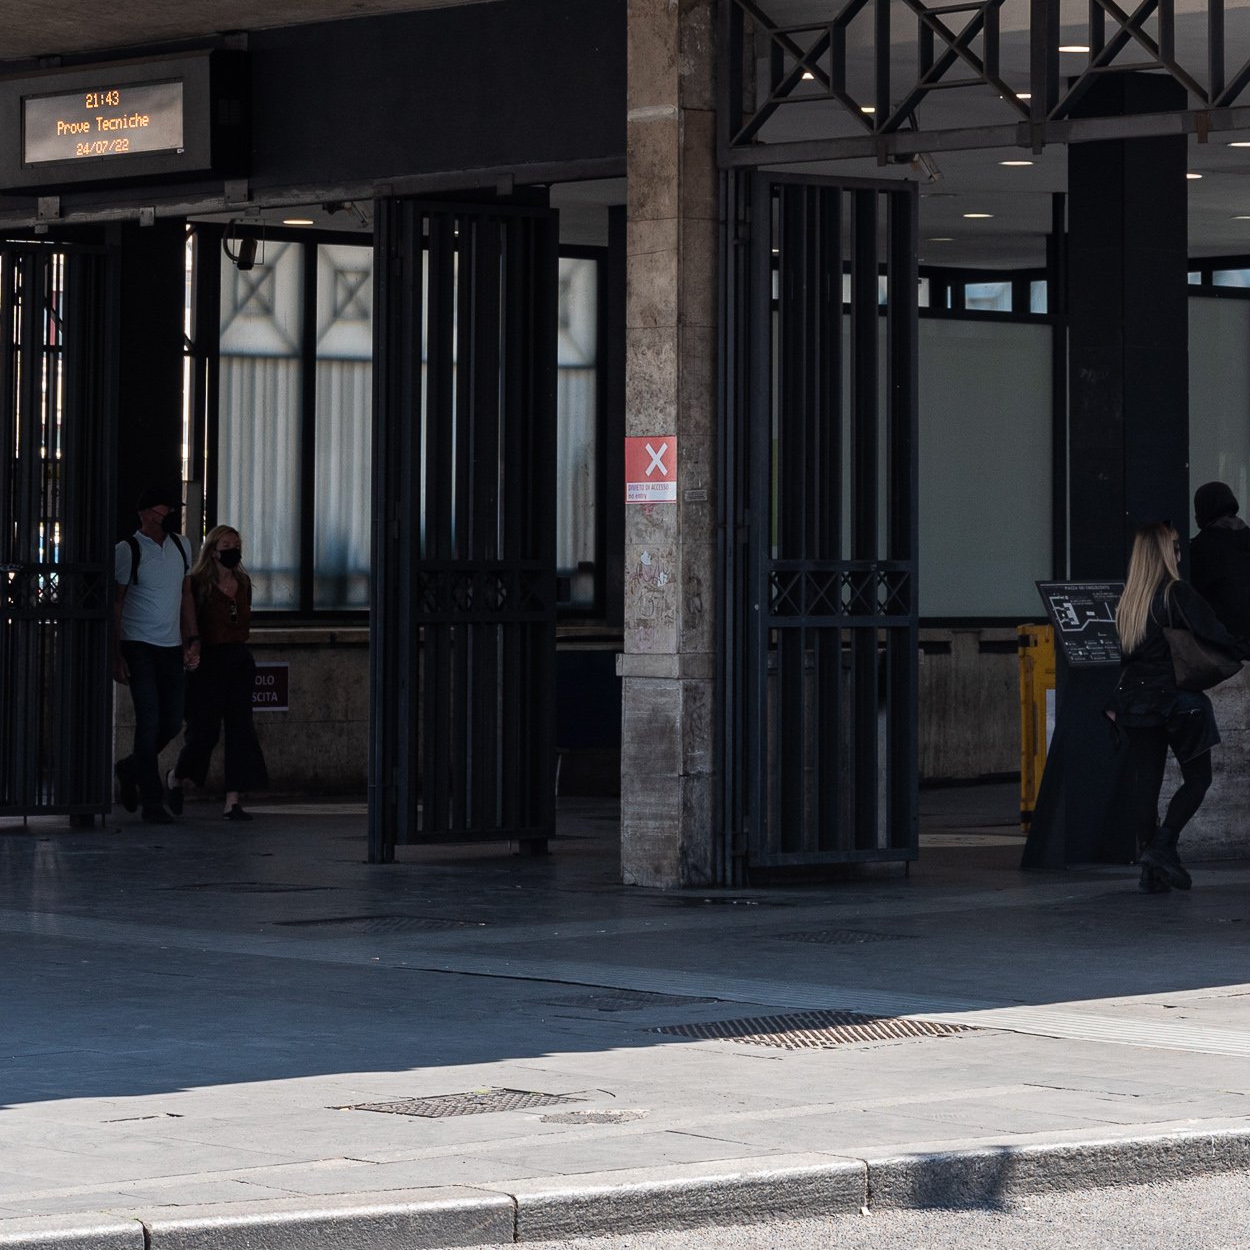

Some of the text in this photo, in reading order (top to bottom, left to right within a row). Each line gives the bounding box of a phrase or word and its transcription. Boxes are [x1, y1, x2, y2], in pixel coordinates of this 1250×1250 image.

[86, 90, 119, 108] 21:43
[57, 113, 149, 135] Prove Tecniche
[76, 139, 129, 156] 24/07/22
[255, 675, 275, 686] OLO
[251, 692, 278, 703] SCITA
